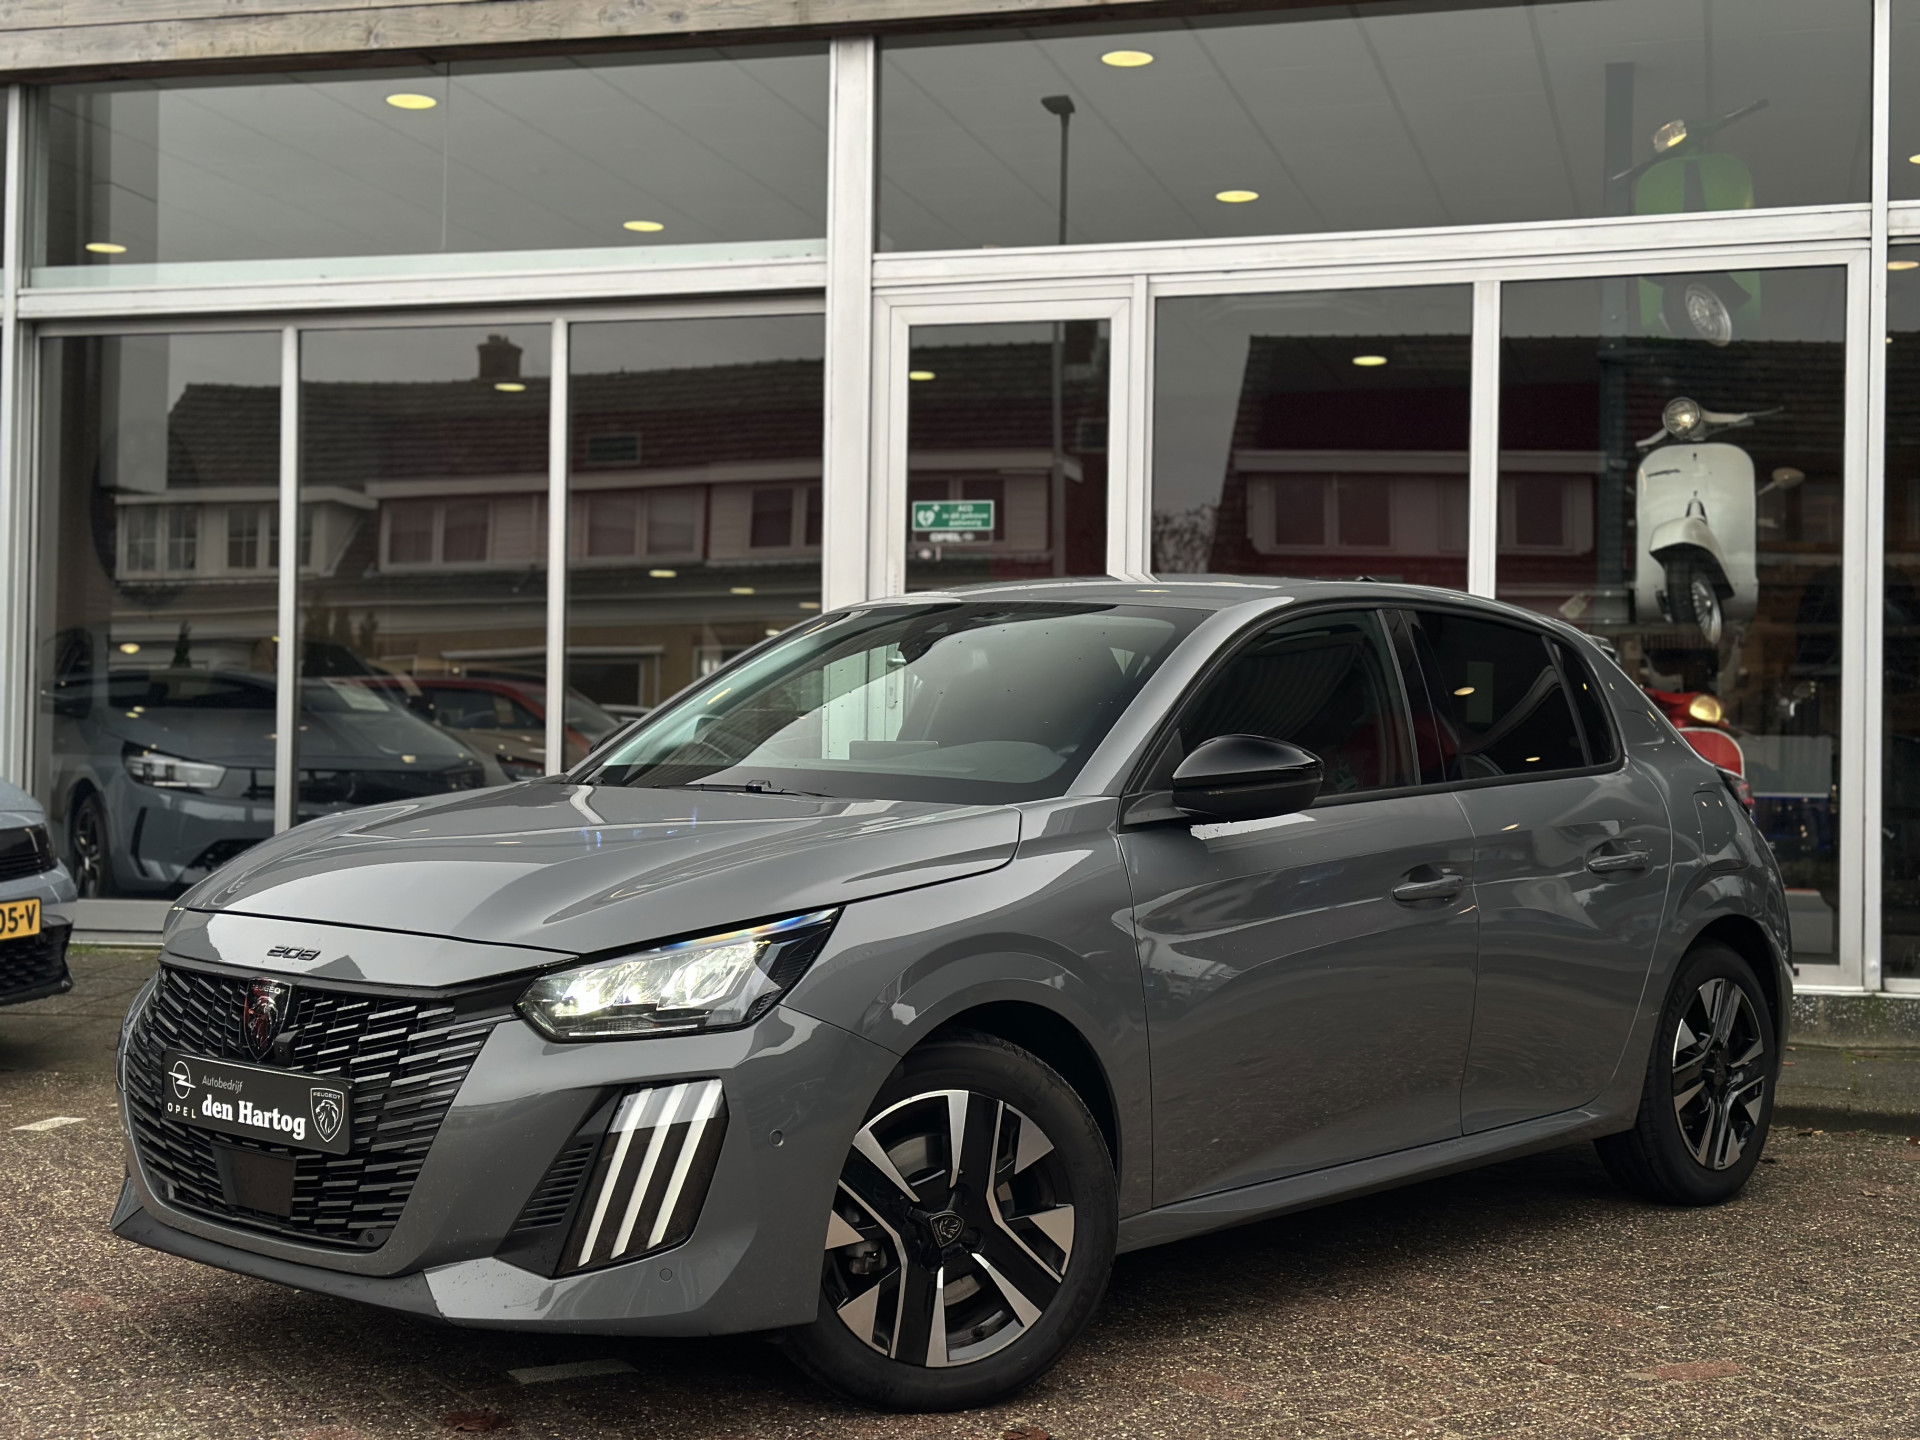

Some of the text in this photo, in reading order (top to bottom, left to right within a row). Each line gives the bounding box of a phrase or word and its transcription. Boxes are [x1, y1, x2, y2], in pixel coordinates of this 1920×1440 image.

[267, 946, 321, 961] 208
[202, 1075, 243, 1094] Autobedrijf
[313, 1091, 342, 1099] PEUGEOT
[167, 1103, 196, 1118] OPEL
[202, 1094, 306, 1140] den Hartog
